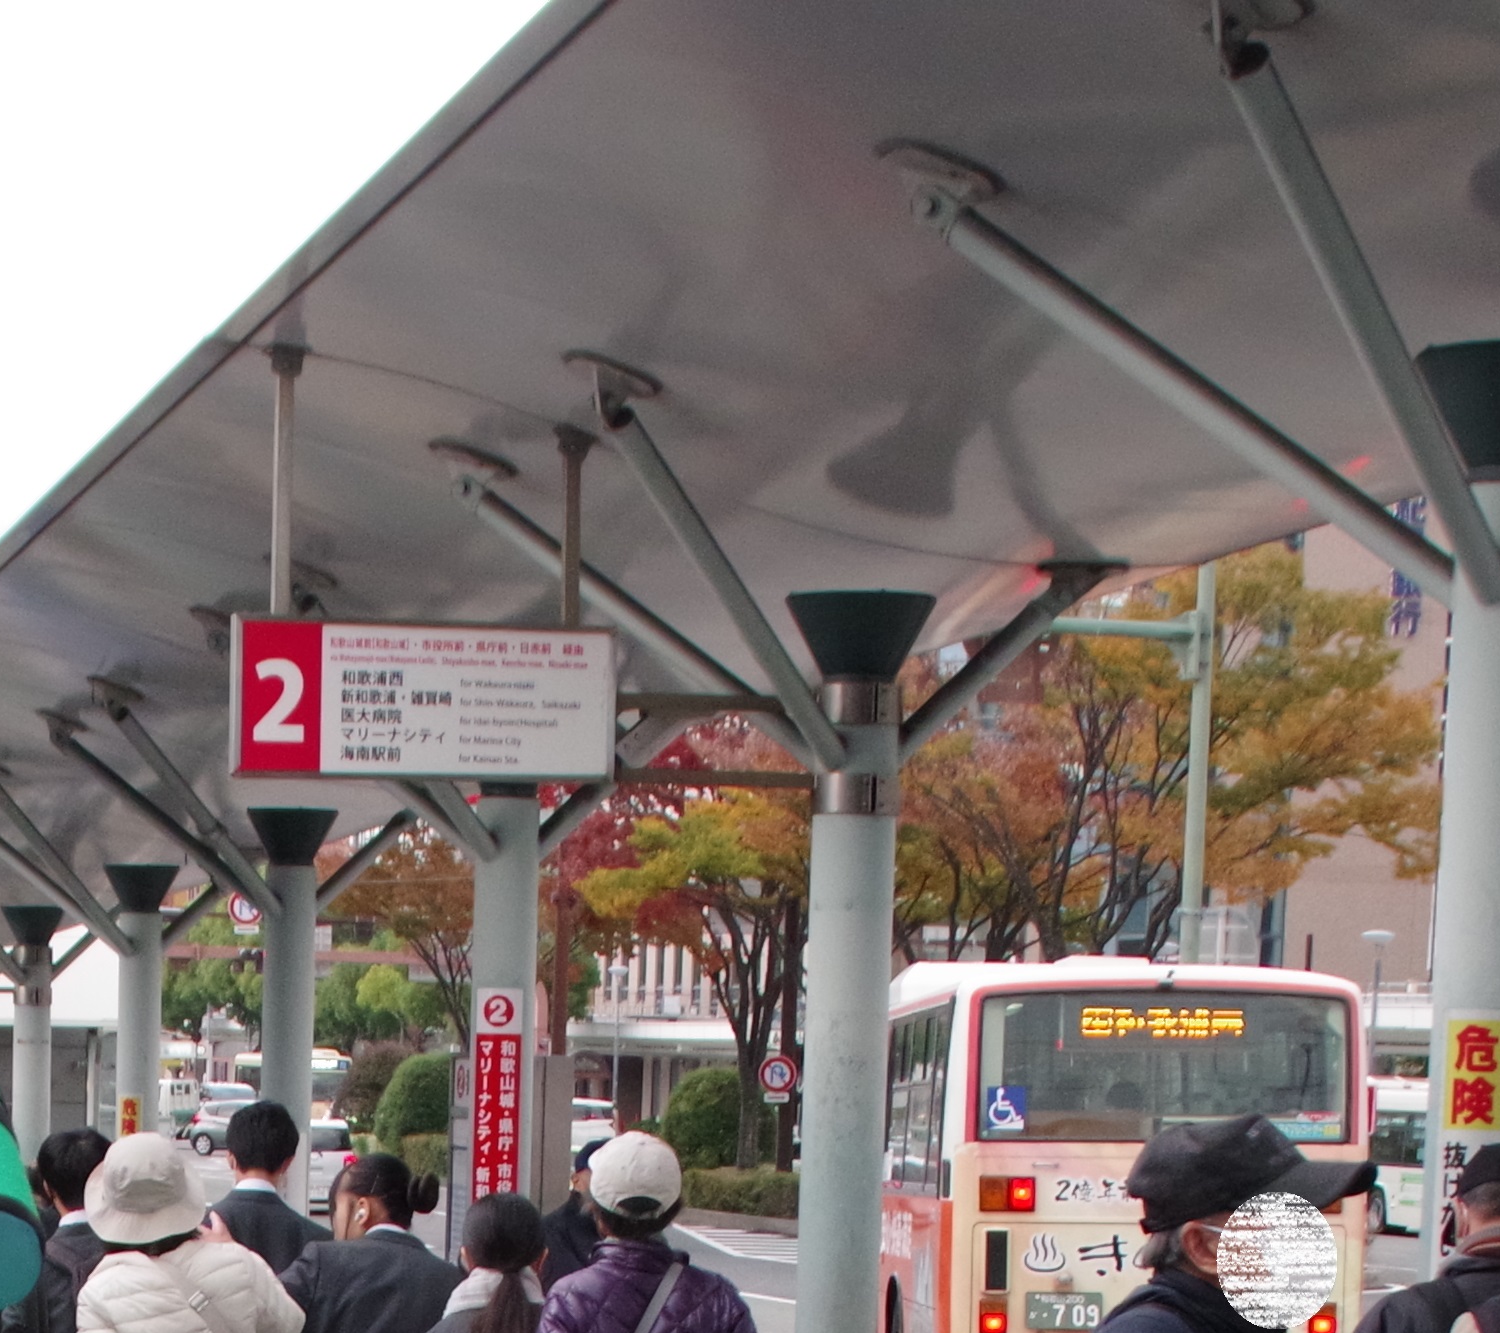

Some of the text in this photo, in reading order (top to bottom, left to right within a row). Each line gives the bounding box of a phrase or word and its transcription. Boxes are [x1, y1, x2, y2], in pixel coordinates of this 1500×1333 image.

[251, 656, 306, 744] 2
[341, 707, 402, 725] 医大病院
[341, 727, 446, 744] マリーナシティ
[340, 745, 401, 763] 海南駅前
[1450, 1023, 1499, 1126] 危険
[1055, 1179, 1130, 1203] 2億年
